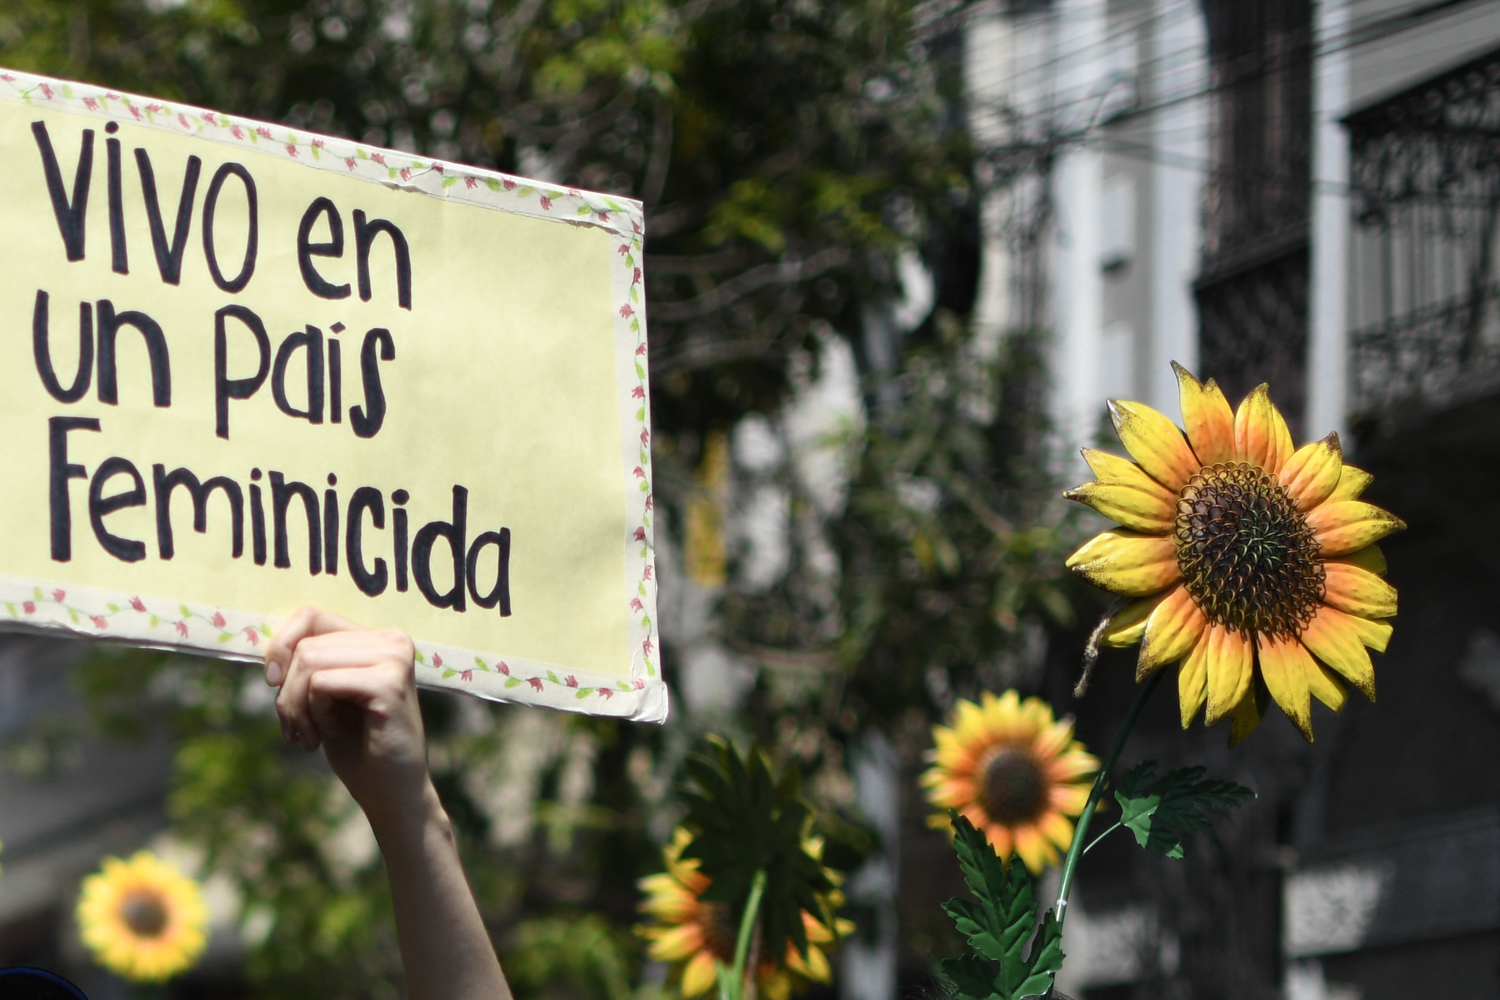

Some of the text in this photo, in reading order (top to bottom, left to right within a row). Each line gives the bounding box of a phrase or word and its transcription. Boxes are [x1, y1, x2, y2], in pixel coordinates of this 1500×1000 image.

[297, 196, 412, 311] en
[32, 289, 172, 408] un
[48, 416, 512, 618] Feminicida
